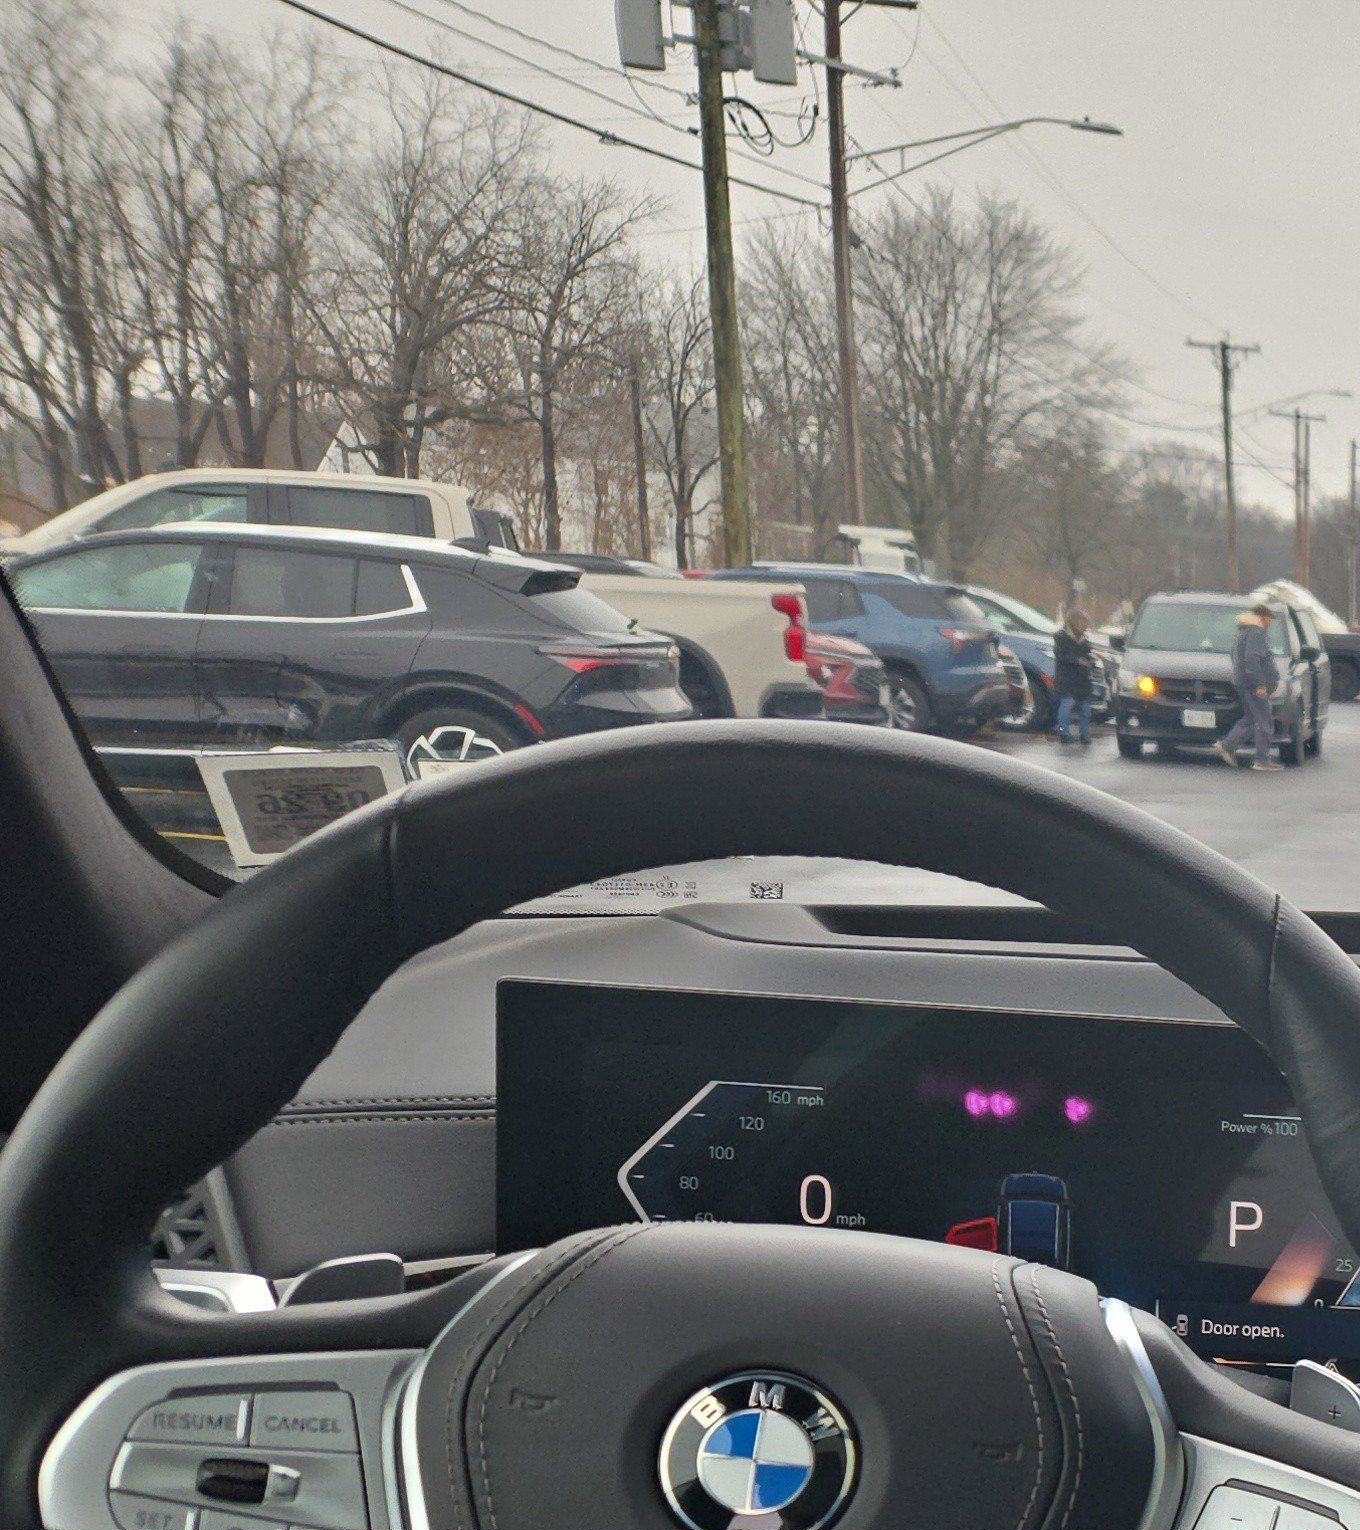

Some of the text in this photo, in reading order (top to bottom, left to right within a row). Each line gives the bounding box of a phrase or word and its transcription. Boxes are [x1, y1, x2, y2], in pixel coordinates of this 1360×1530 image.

[766, 1090, 825, 1108] 160 mph
[739, 1116, 765, 1132] 120
[1220, 1120, 1258, 1134] Power
[1274, 1121, 1299, 1137] 100
[708, 1145, 735, 1161] 100
[679, 1175, 700, 1190] 80
[799, 1174, 866, 1228] 0 mph
[694, 1212, 714, 1222] 60
[1228, 1201, 1264, 1248] P
[1335, 1258, 1354, 1273] 25
[1201, 1318, 1285, 1340] Door open.
[689, 1380, 841, 1443] BMW
[153, 1411, 342, 1434] RESUME CANCEL
[134, 1511, 173, 1530] SET
